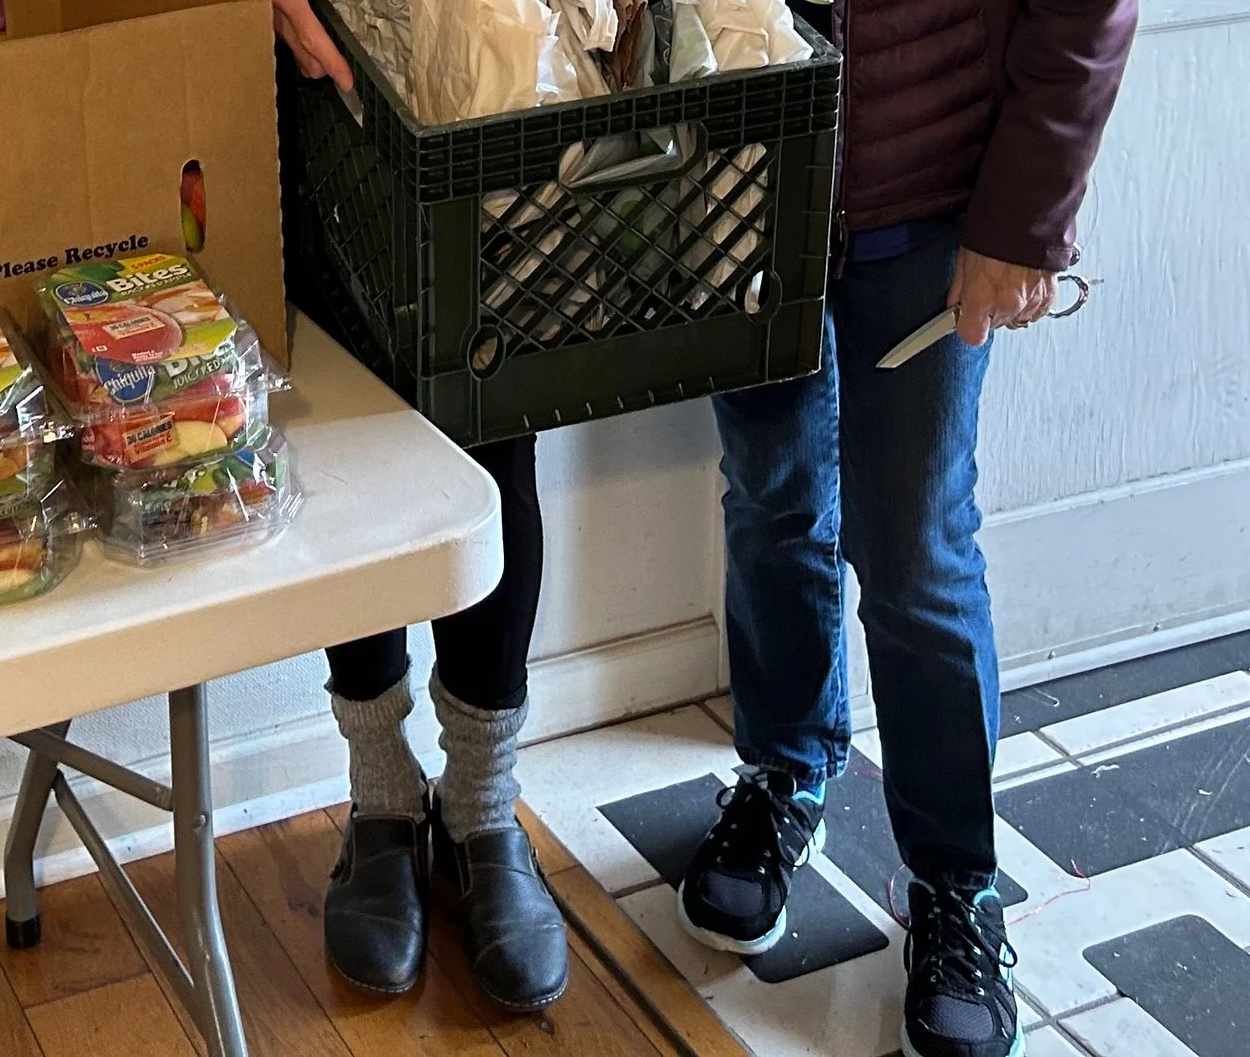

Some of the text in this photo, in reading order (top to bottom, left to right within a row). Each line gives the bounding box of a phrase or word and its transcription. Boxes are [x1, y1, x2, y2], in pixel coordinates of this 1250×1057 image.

[64, 235, 148, 264] Recycle
[106, 264, 188, 292] Bites
[64, 290, 109, 304] Chiquita
[104, 364, 156, 395] Chiquita
[138, 421, 172, 440] CALORIES
